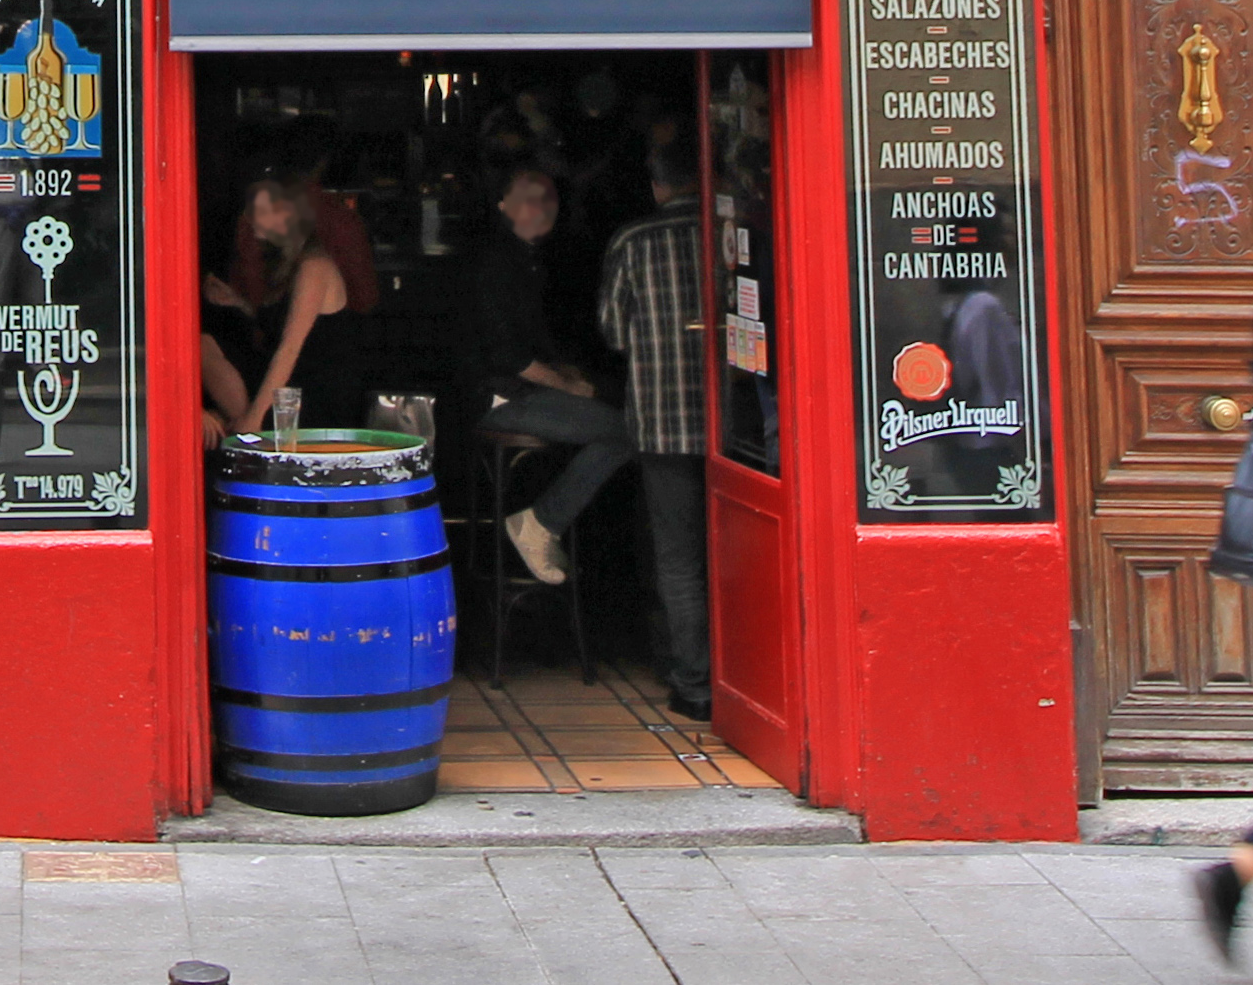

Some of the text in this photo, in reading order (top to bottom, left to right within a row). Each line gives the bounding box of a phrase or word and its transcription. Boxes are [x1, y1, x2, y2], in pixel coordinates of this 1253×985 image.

[865, 41, 1011, 69] ESCABECHES
[883, 91, 996, 119] CHACINAS
[879, 141, 1005, 169] AHUMADOS
[19, 169, 72, 197] 1.892
[891, 191, 996, 219] ANCHOAS
[932, 224, 957, 246] DE
[883, 252, 1008, 279] CANTABRIA
[1, 329, 99, 364] DE REUS
[880, 397, 1018, 453] Pilsner Urquell
